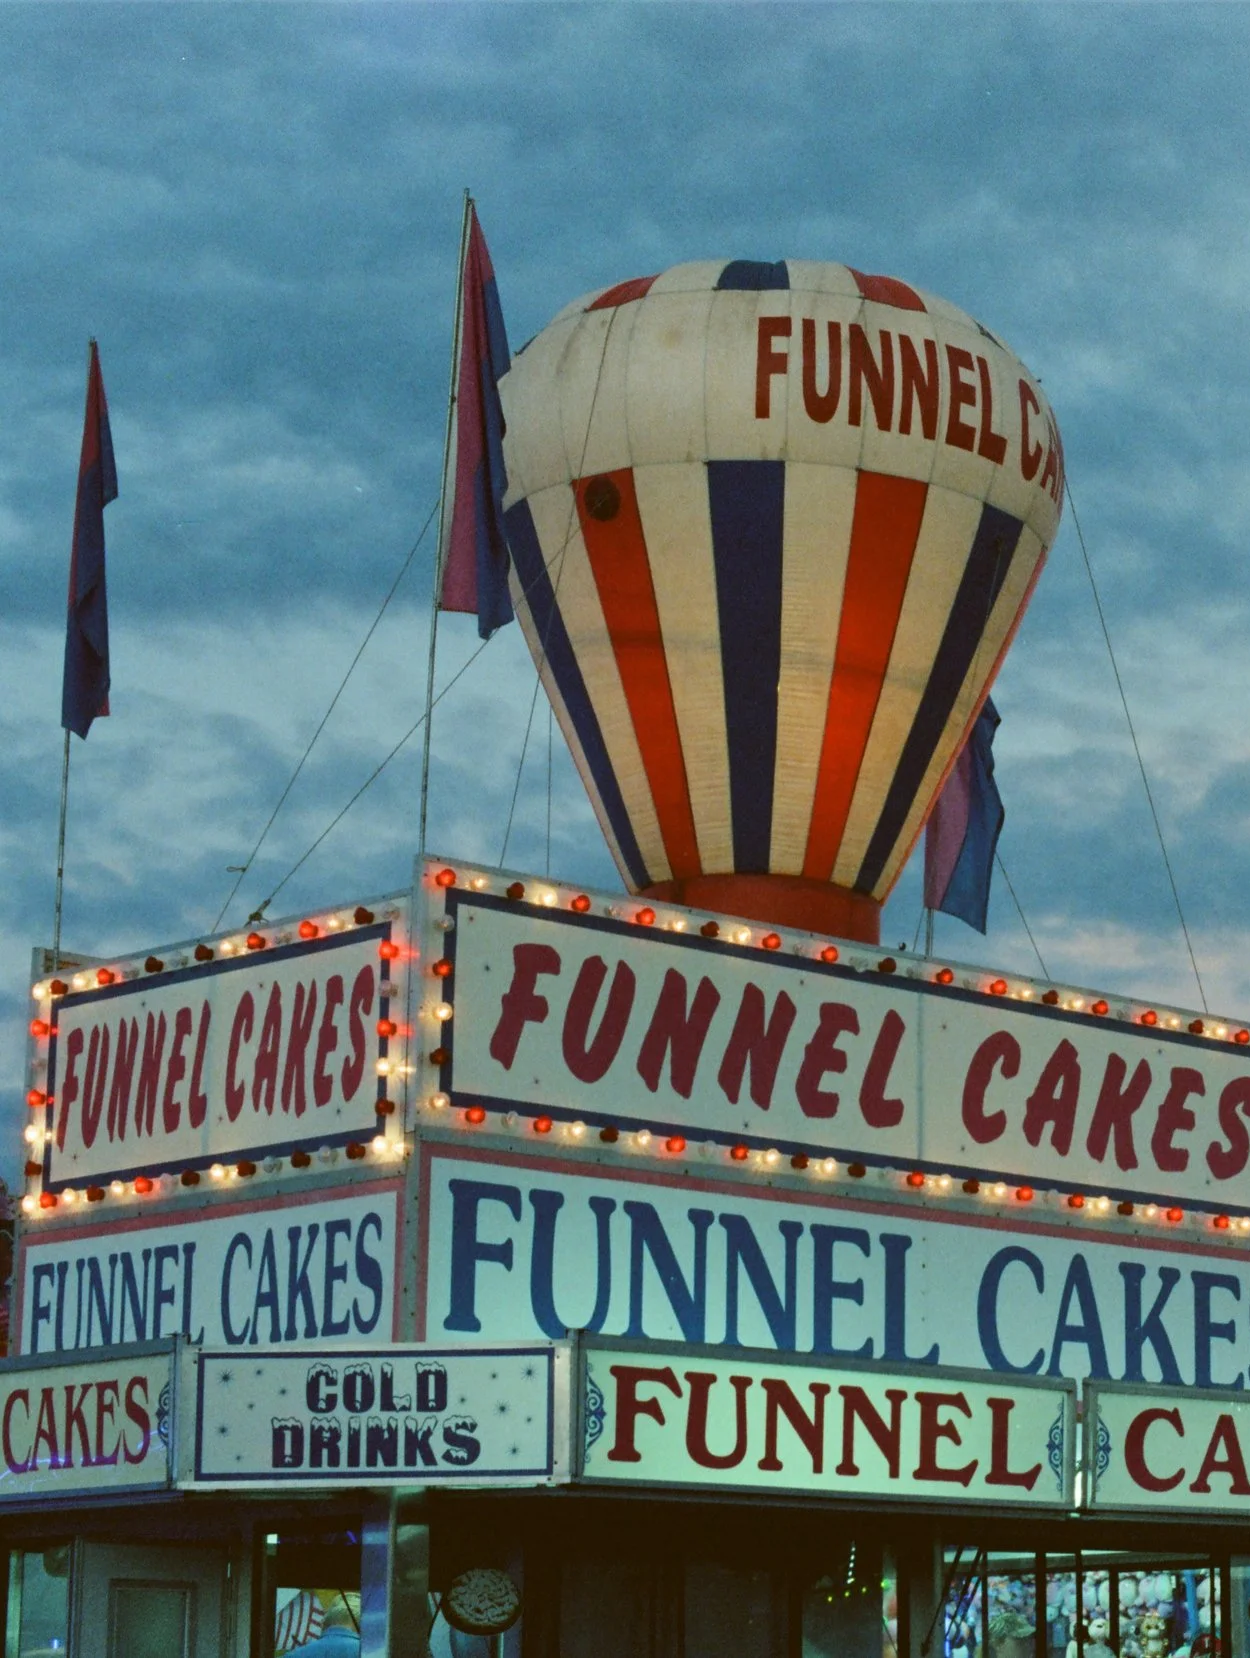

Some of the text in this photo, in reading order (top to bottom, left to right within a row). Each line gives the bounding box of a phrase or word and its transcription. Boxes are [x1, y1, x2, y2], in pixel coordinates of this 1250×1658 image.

[755, 316, 1008, 465] FUNNEL
[56, 964, 375, 1153] FUNNEL CAKES
[488, 942, 907, 1129] FUNNEL
[30, 1212, 384, 1354] FUNNEL CAKES
[443, 1178, 940, 1366] FUNNEL
[3, 1375, 152, 1474] CAKES
[271, 1414, 481, 1468] DRINKS
[306, 1361, 448, 1414] COLD
[607, 1365, 1042, 1491] FUNNEL
